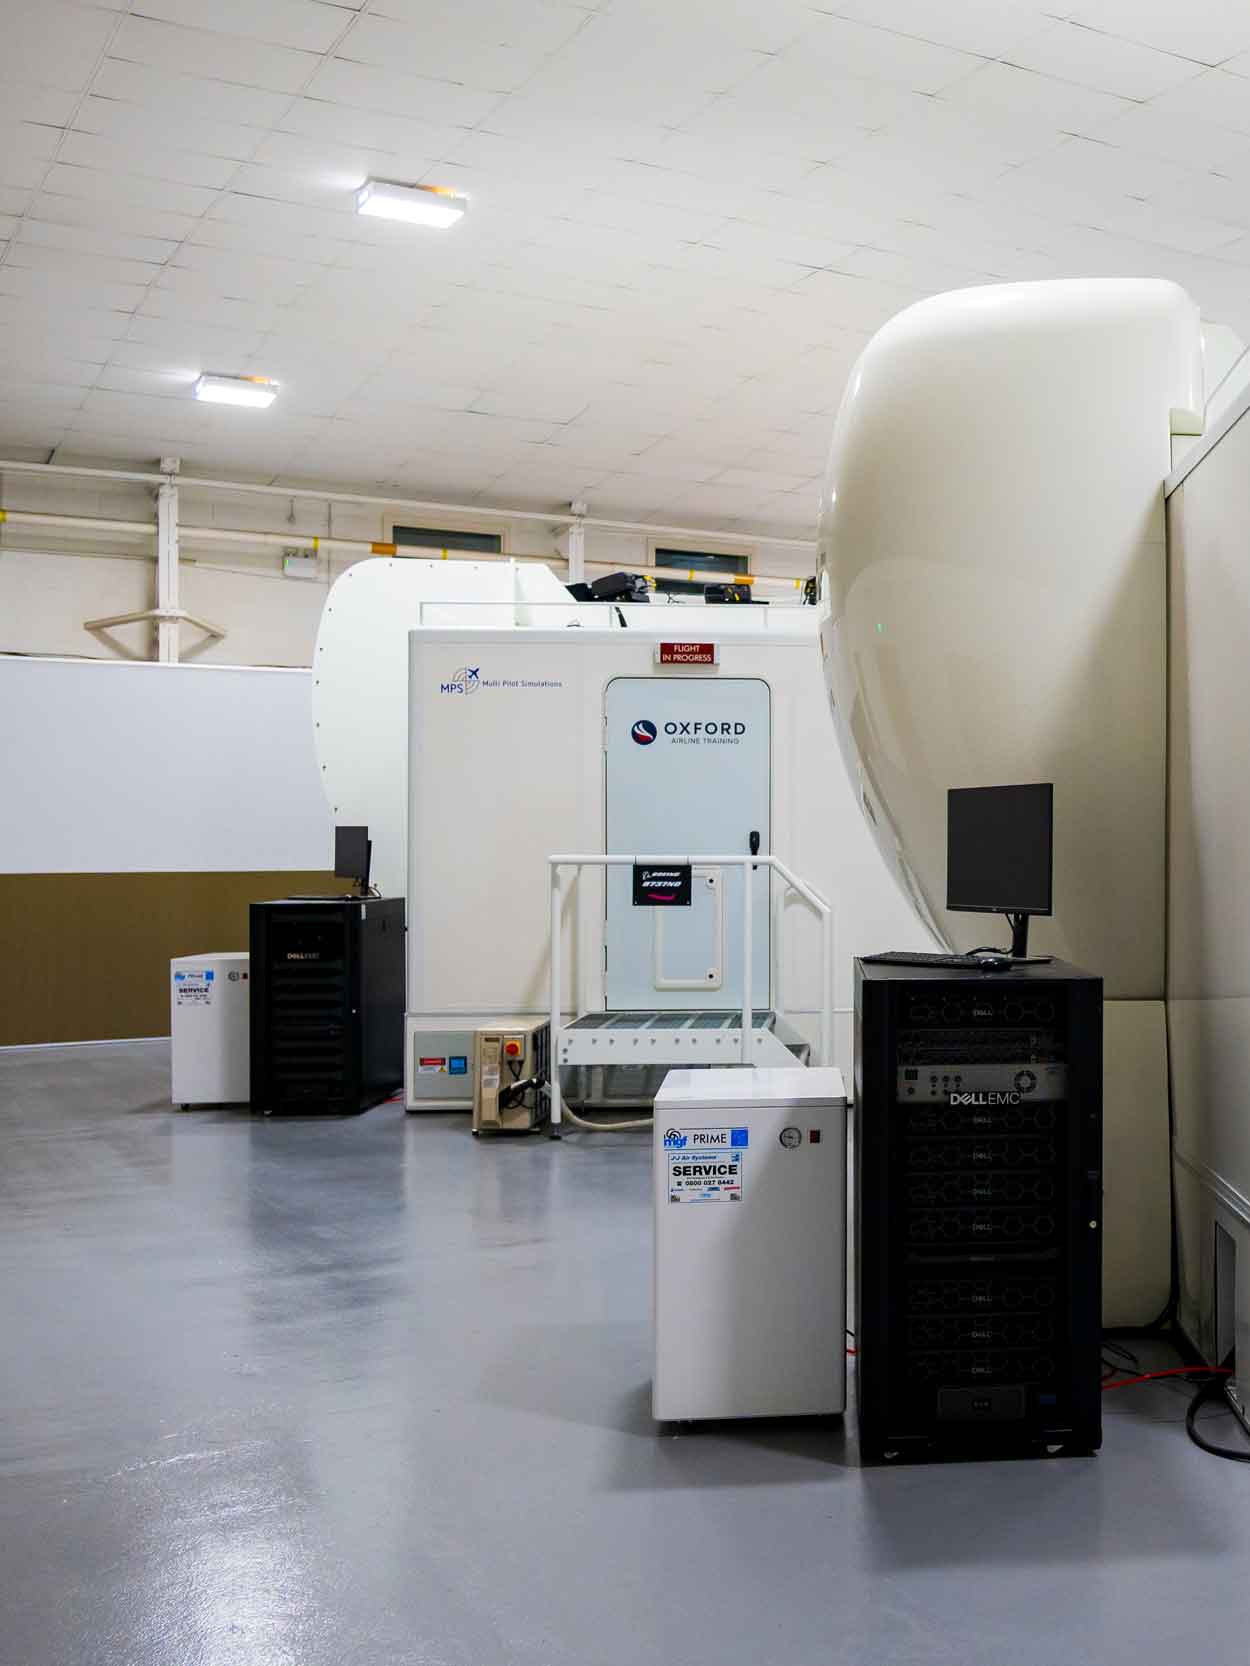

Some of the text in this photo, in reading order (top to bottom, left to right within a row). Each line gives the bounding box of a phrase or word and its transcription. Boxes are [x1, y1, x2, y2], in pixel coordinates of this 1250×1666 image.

[674, 644, 700, 652] FLIGHT
[673, 654, 712, 662] PROGRESS
[440, 683, 464, 693] MPS
[502, 680, 519, 688] Pilot
[664, 722, 746, 735] OXFORD
[693, 1133, 727, 1144] PRIME
[672, 1164, 738, 1176] SERVICE
